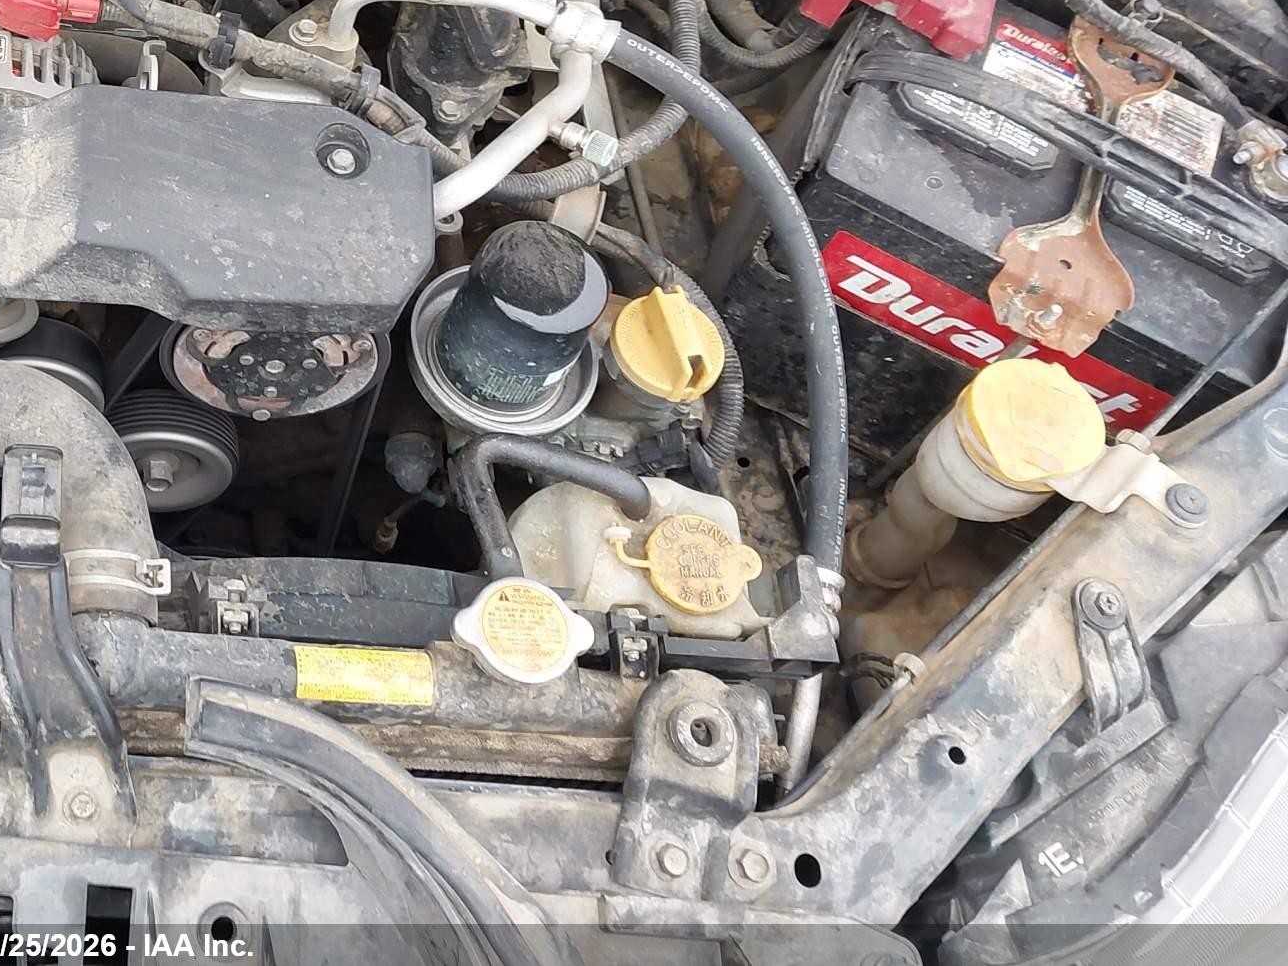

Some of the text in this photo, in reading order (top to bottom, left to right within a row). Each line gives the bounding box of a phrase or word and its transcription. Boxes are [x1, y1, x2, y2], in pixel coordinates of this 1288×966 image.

[837, 254, 1143, 424] Duralt
[655, 517, 732, 549] COOLANT
[679, 566, 721, 578] MANUAL
